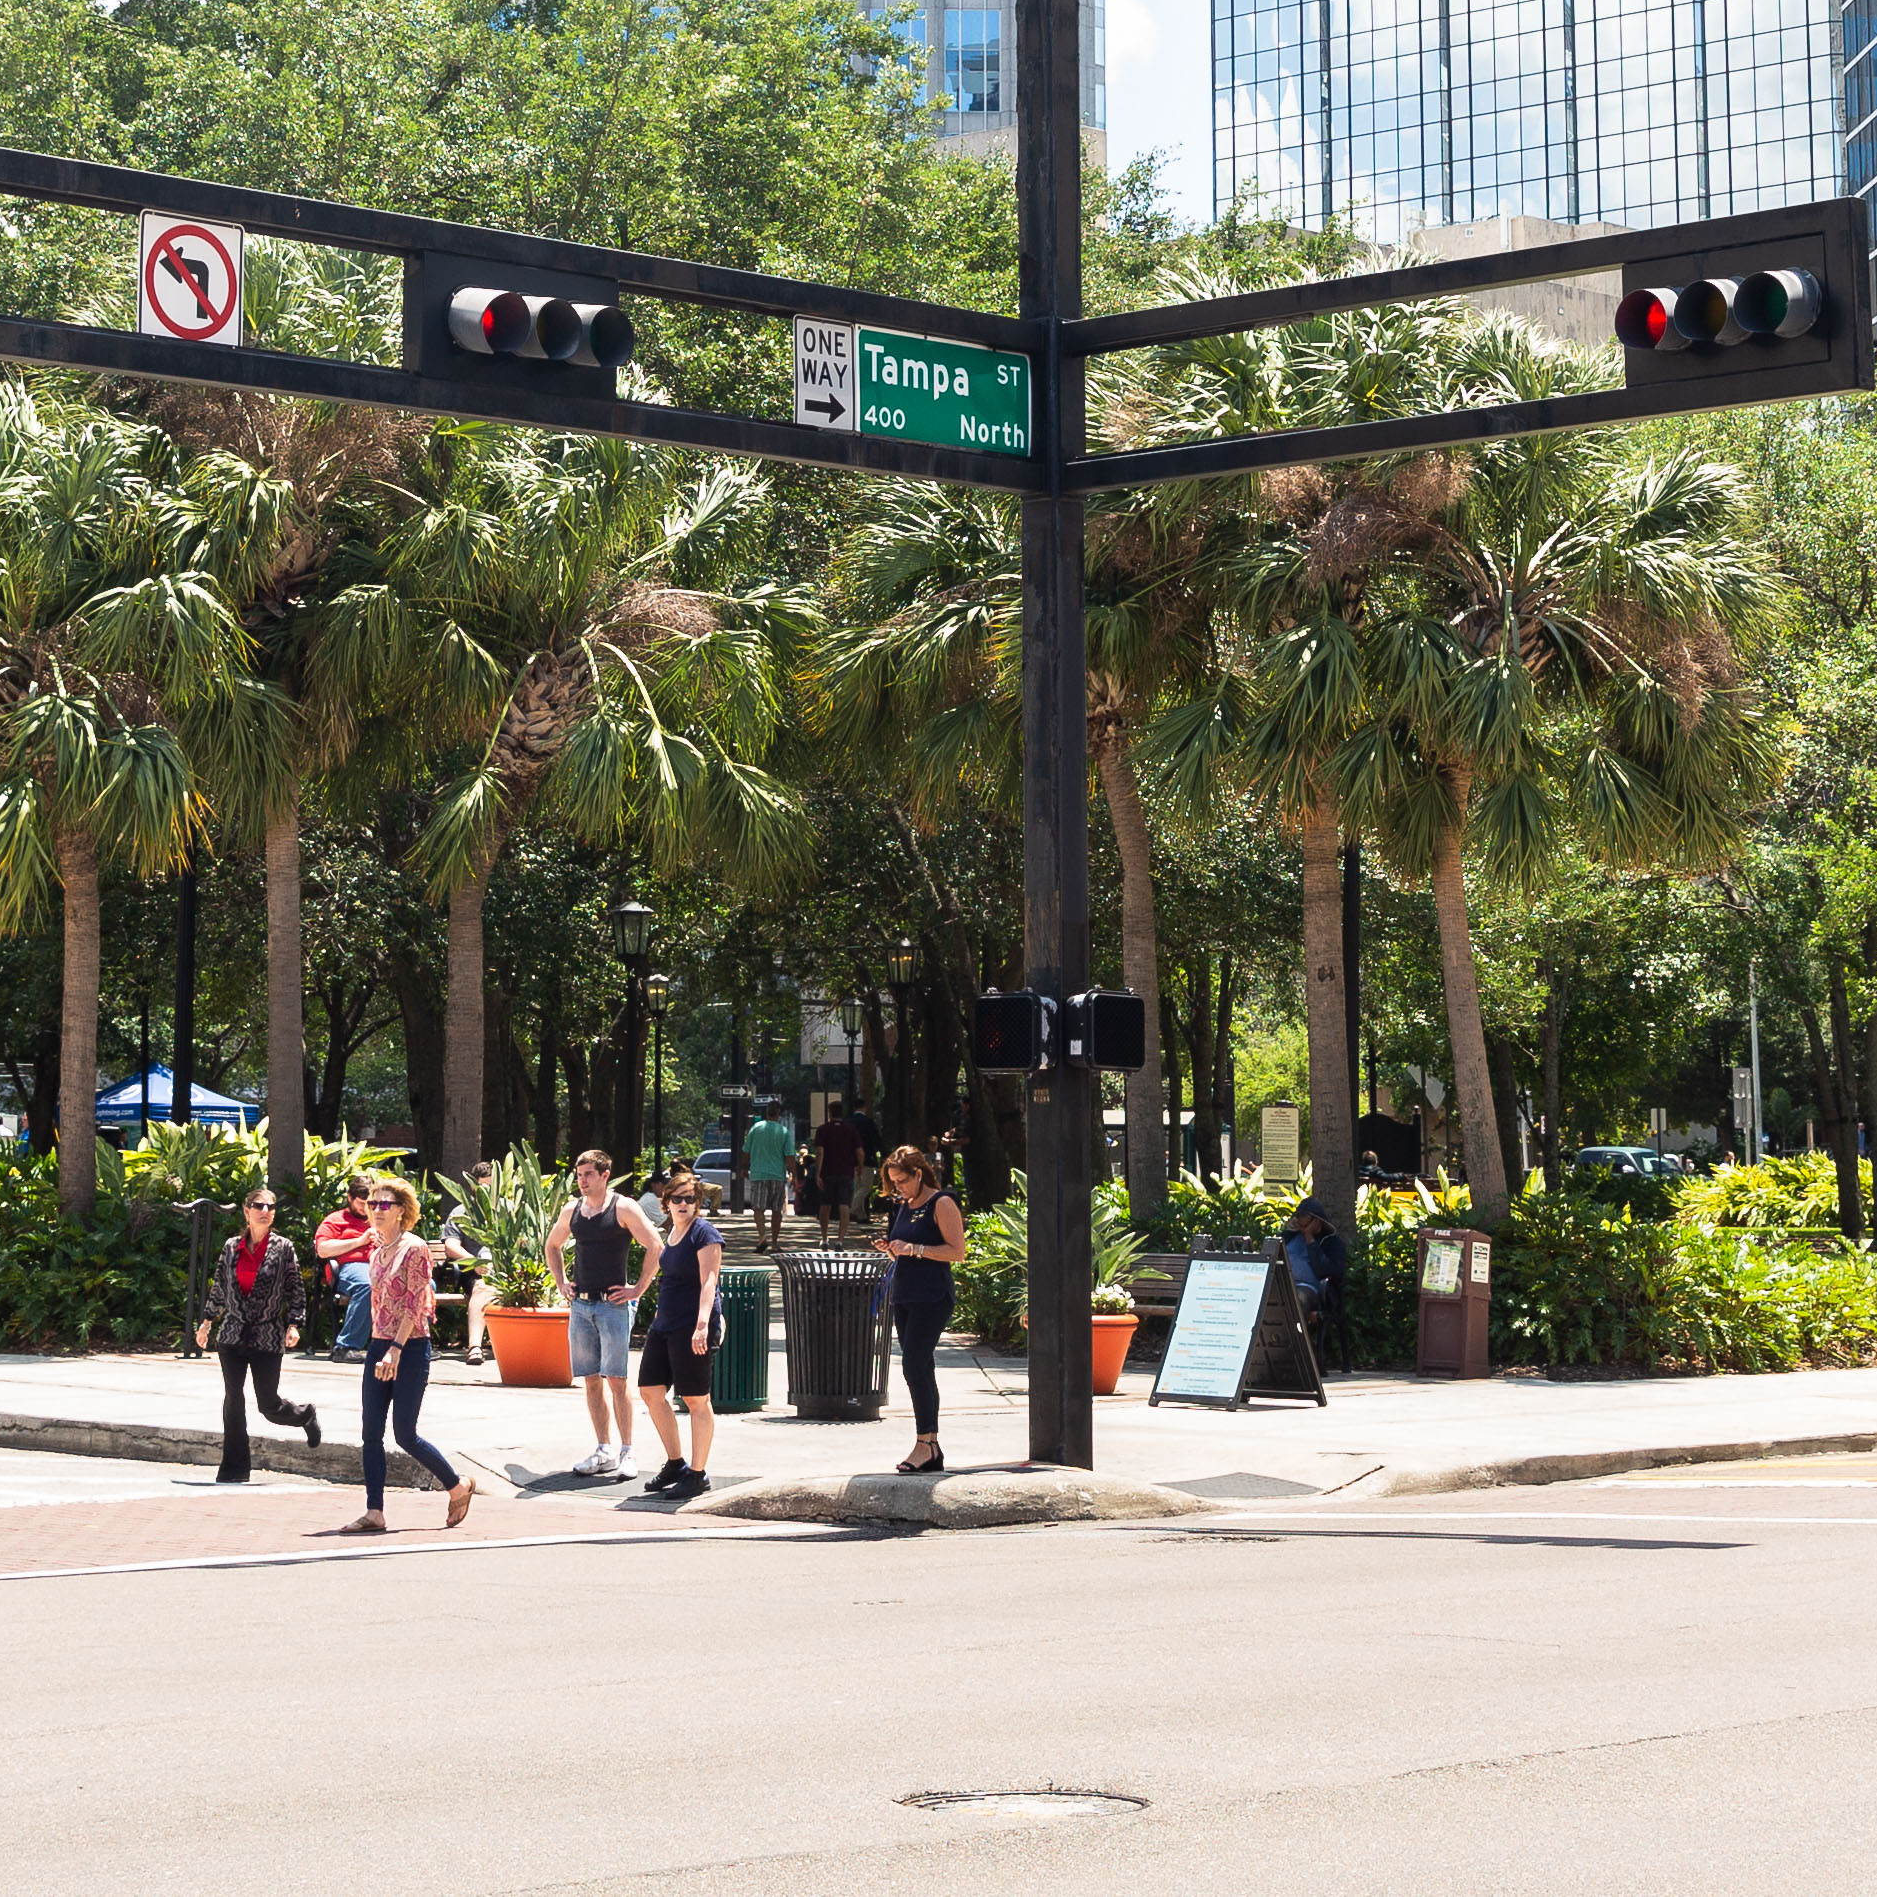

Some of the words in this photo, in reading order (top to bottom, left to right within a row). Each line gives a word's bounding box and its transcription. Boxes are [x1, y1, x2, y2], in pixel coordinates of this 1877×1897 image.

[802, 326, 847, 358] ONE
[801, 357, 848, 389] WAY
[864, 343, 970, 401] Tampa
[996, 364, 1021, 387] ST
[864, 404, 906, 430] 400
[959, 414, 1025, 449] North
